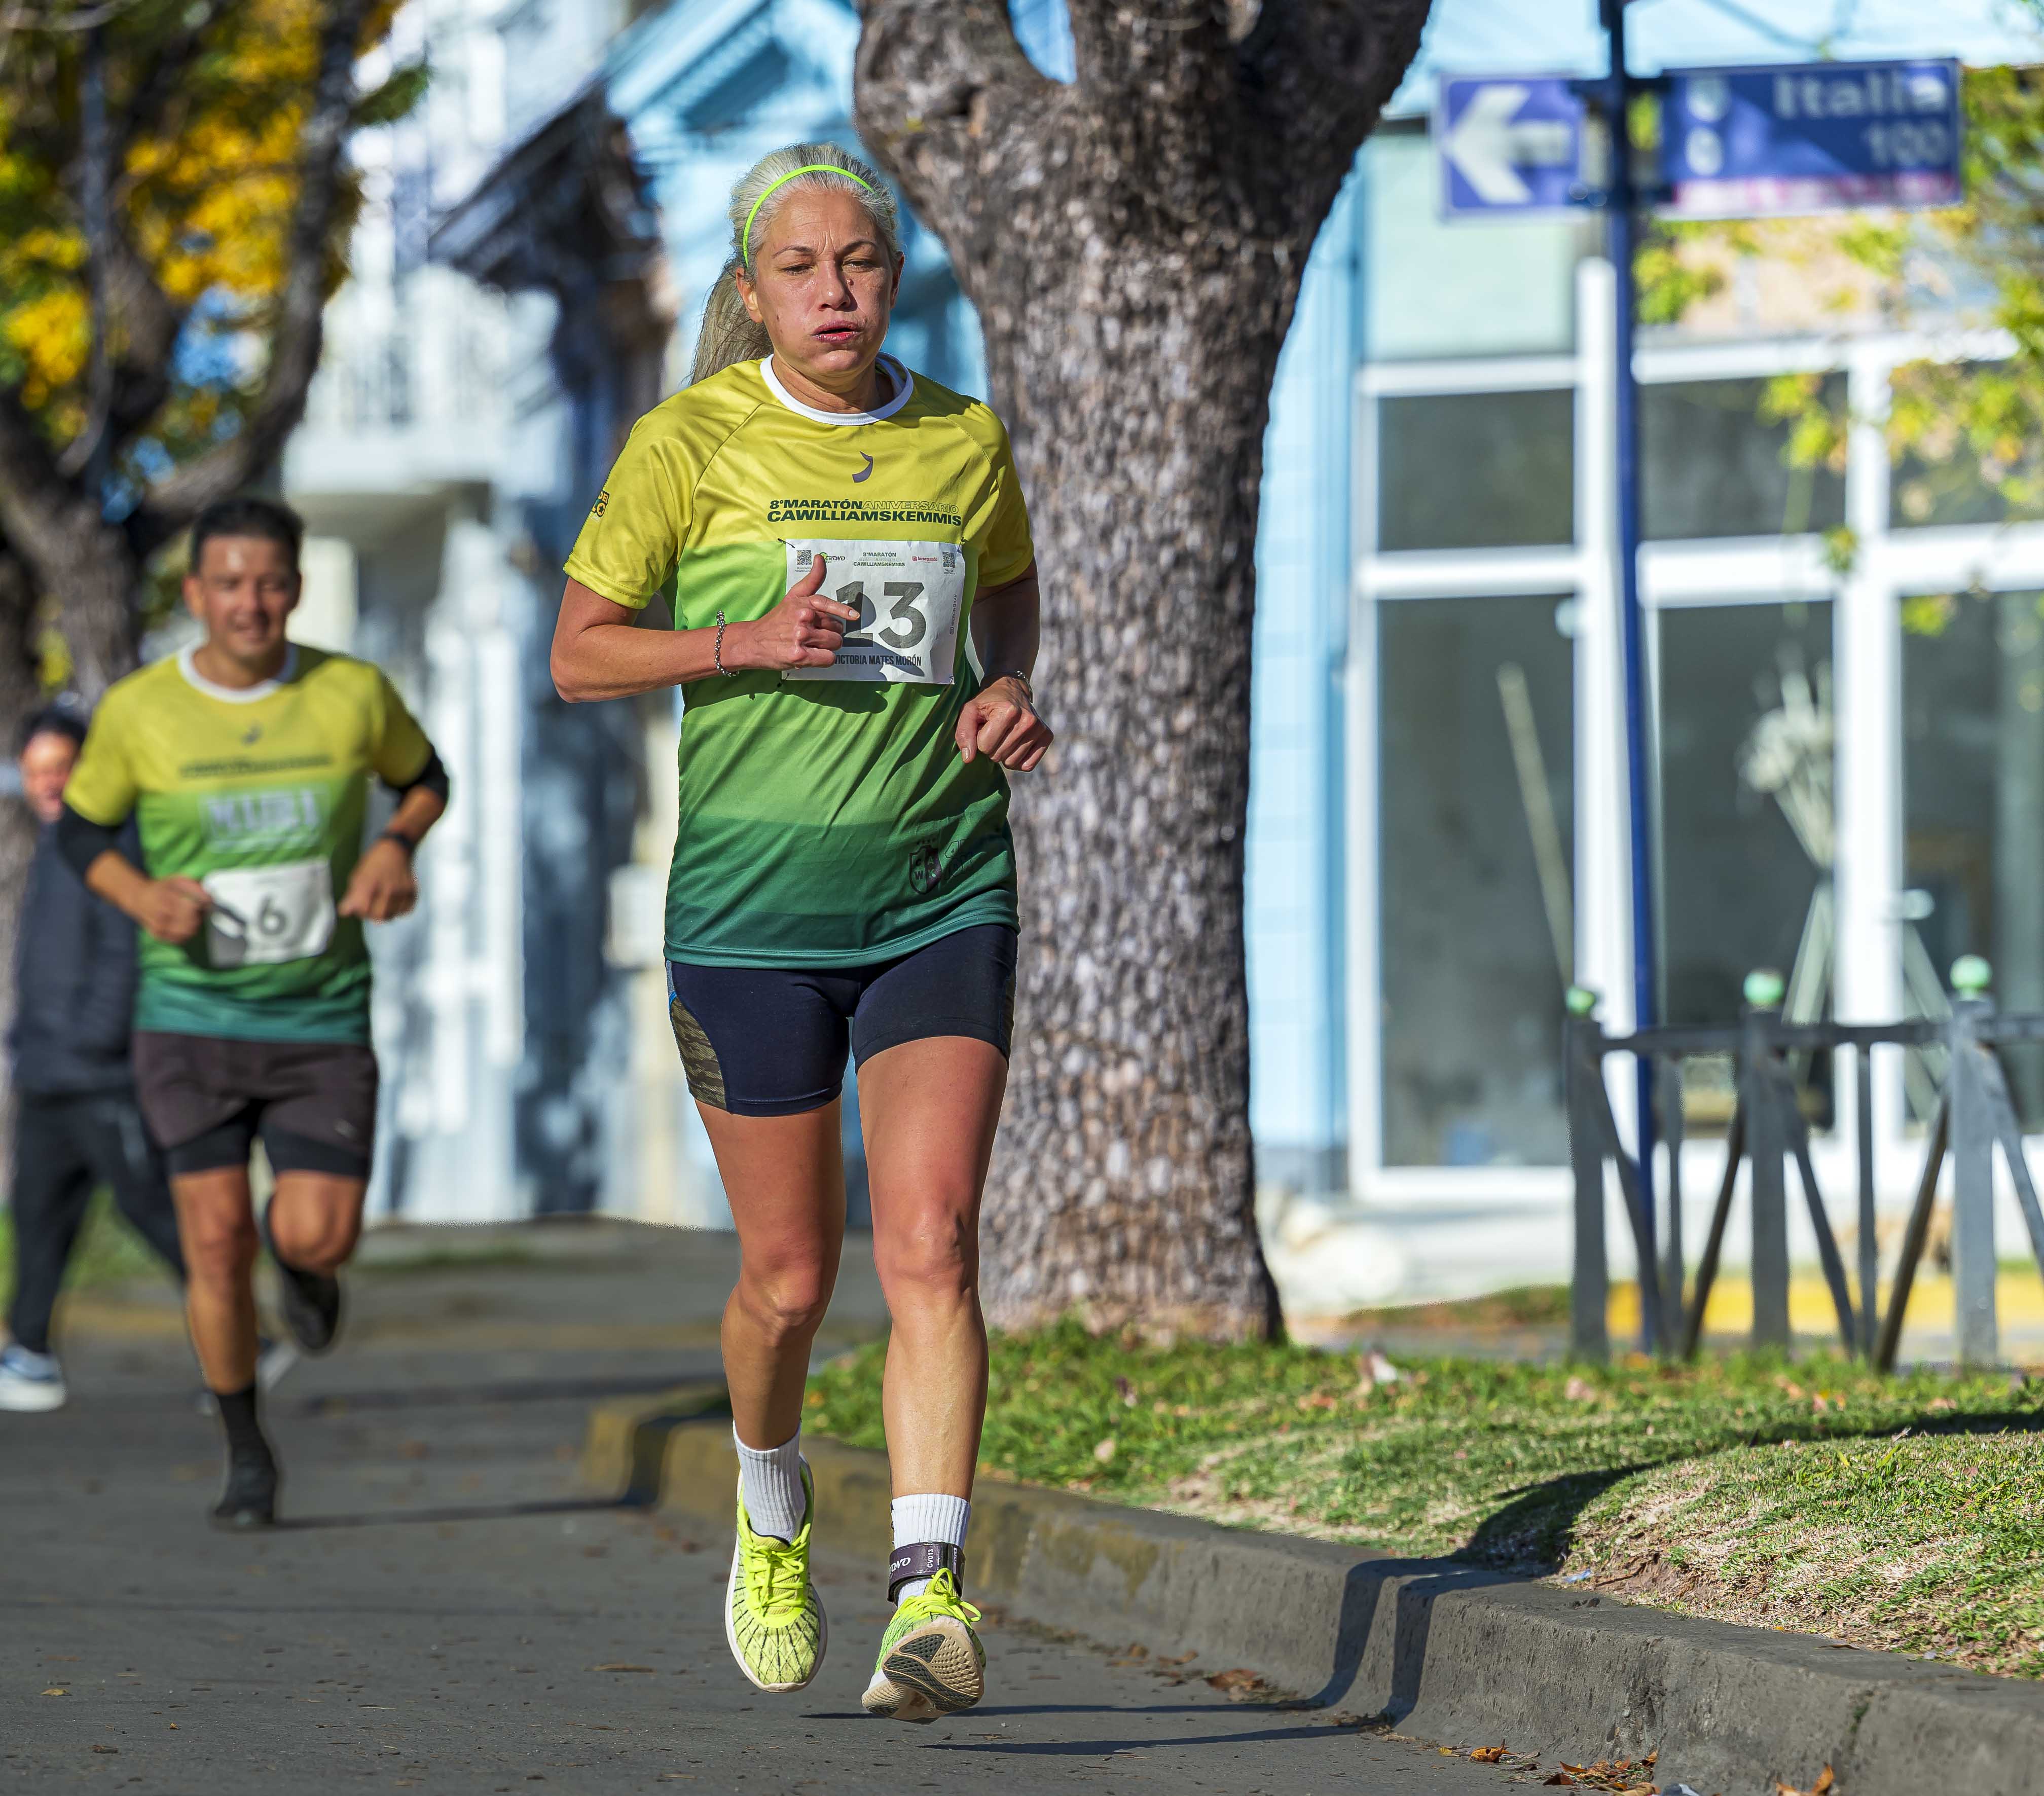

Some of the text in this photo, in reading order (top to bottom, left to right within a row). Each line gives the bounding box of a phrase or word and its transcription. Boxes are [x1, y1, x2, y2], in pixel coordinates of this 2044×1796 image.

[1867, 123, 1948, 167] 100
[767, 509, 962, 526] CAWILLIAMSKEMMIS
[836, 581, 926, 648] 13
[868, 654, 894, 665] MATES
[895, 654, 922, 666] MORÓN
[258, 896, 286, 936] 6
